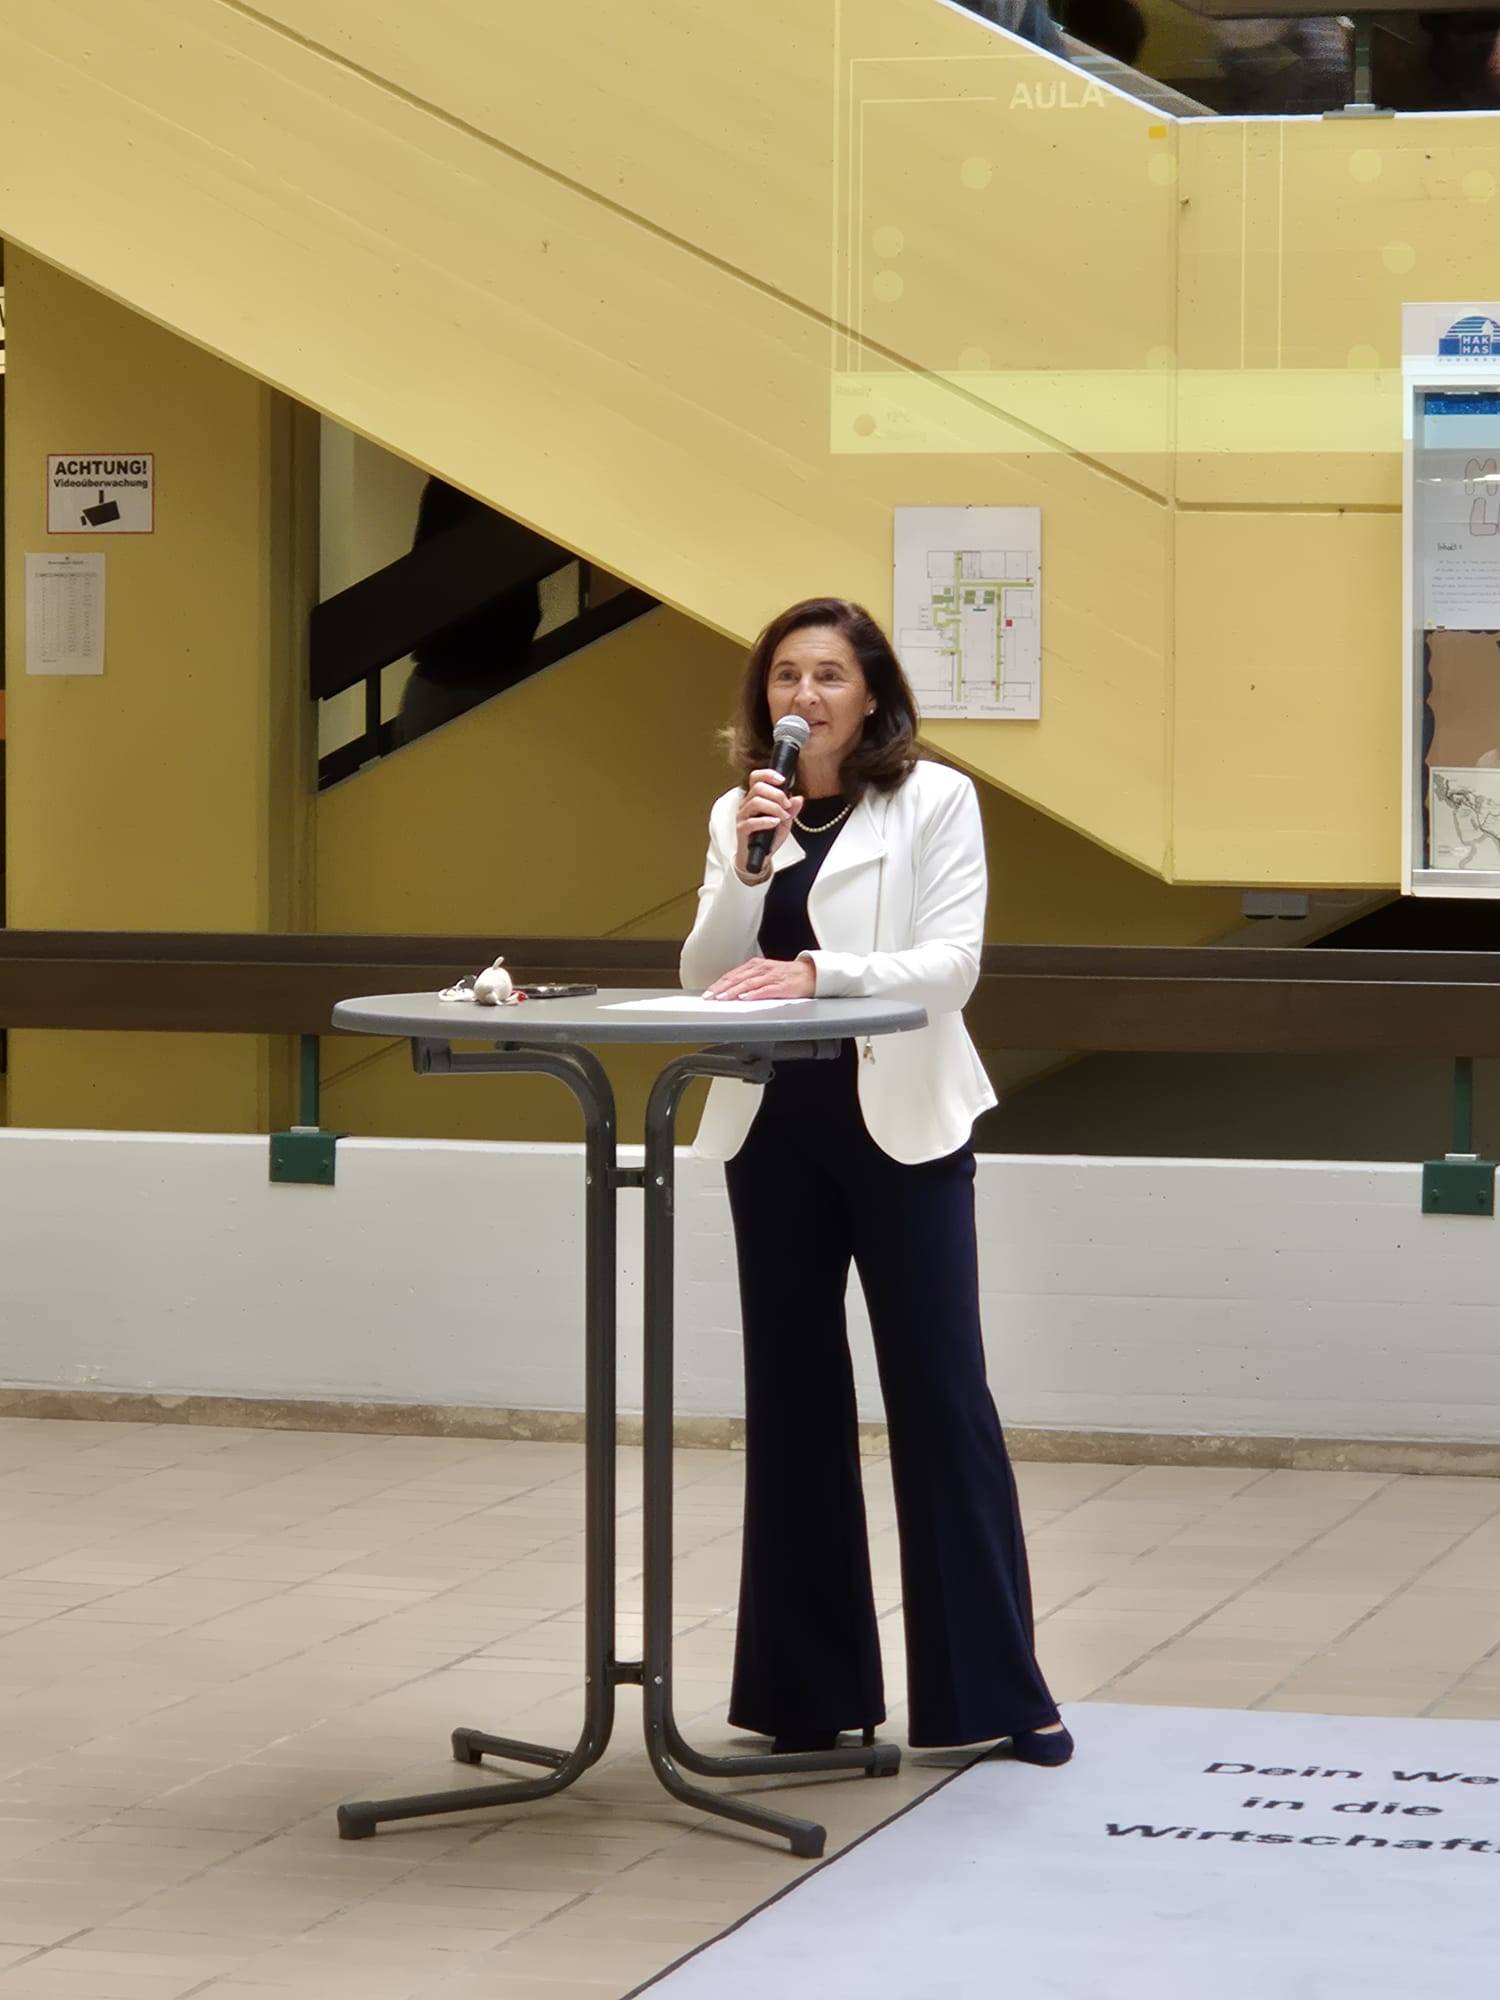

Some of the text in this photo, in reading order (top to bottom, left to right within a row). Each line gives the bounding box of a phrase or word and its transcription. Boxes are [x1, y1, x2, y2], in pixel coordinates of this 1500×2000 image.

[1008, 81, 1105, 110] AULA
[1462, 335, 1489, 345] HAK
[1462, 345, 1489, 354] HAS
[55, 460, 147, 475] ACHTUNG!
[54, 479, 148, 489] Videoüberwachung
[1203, 1762, 1363, 1779] Dein
[1240, 1796, 1443, 1817] in die
[1106, 1823, 1500, 1854] Wirtschaft
